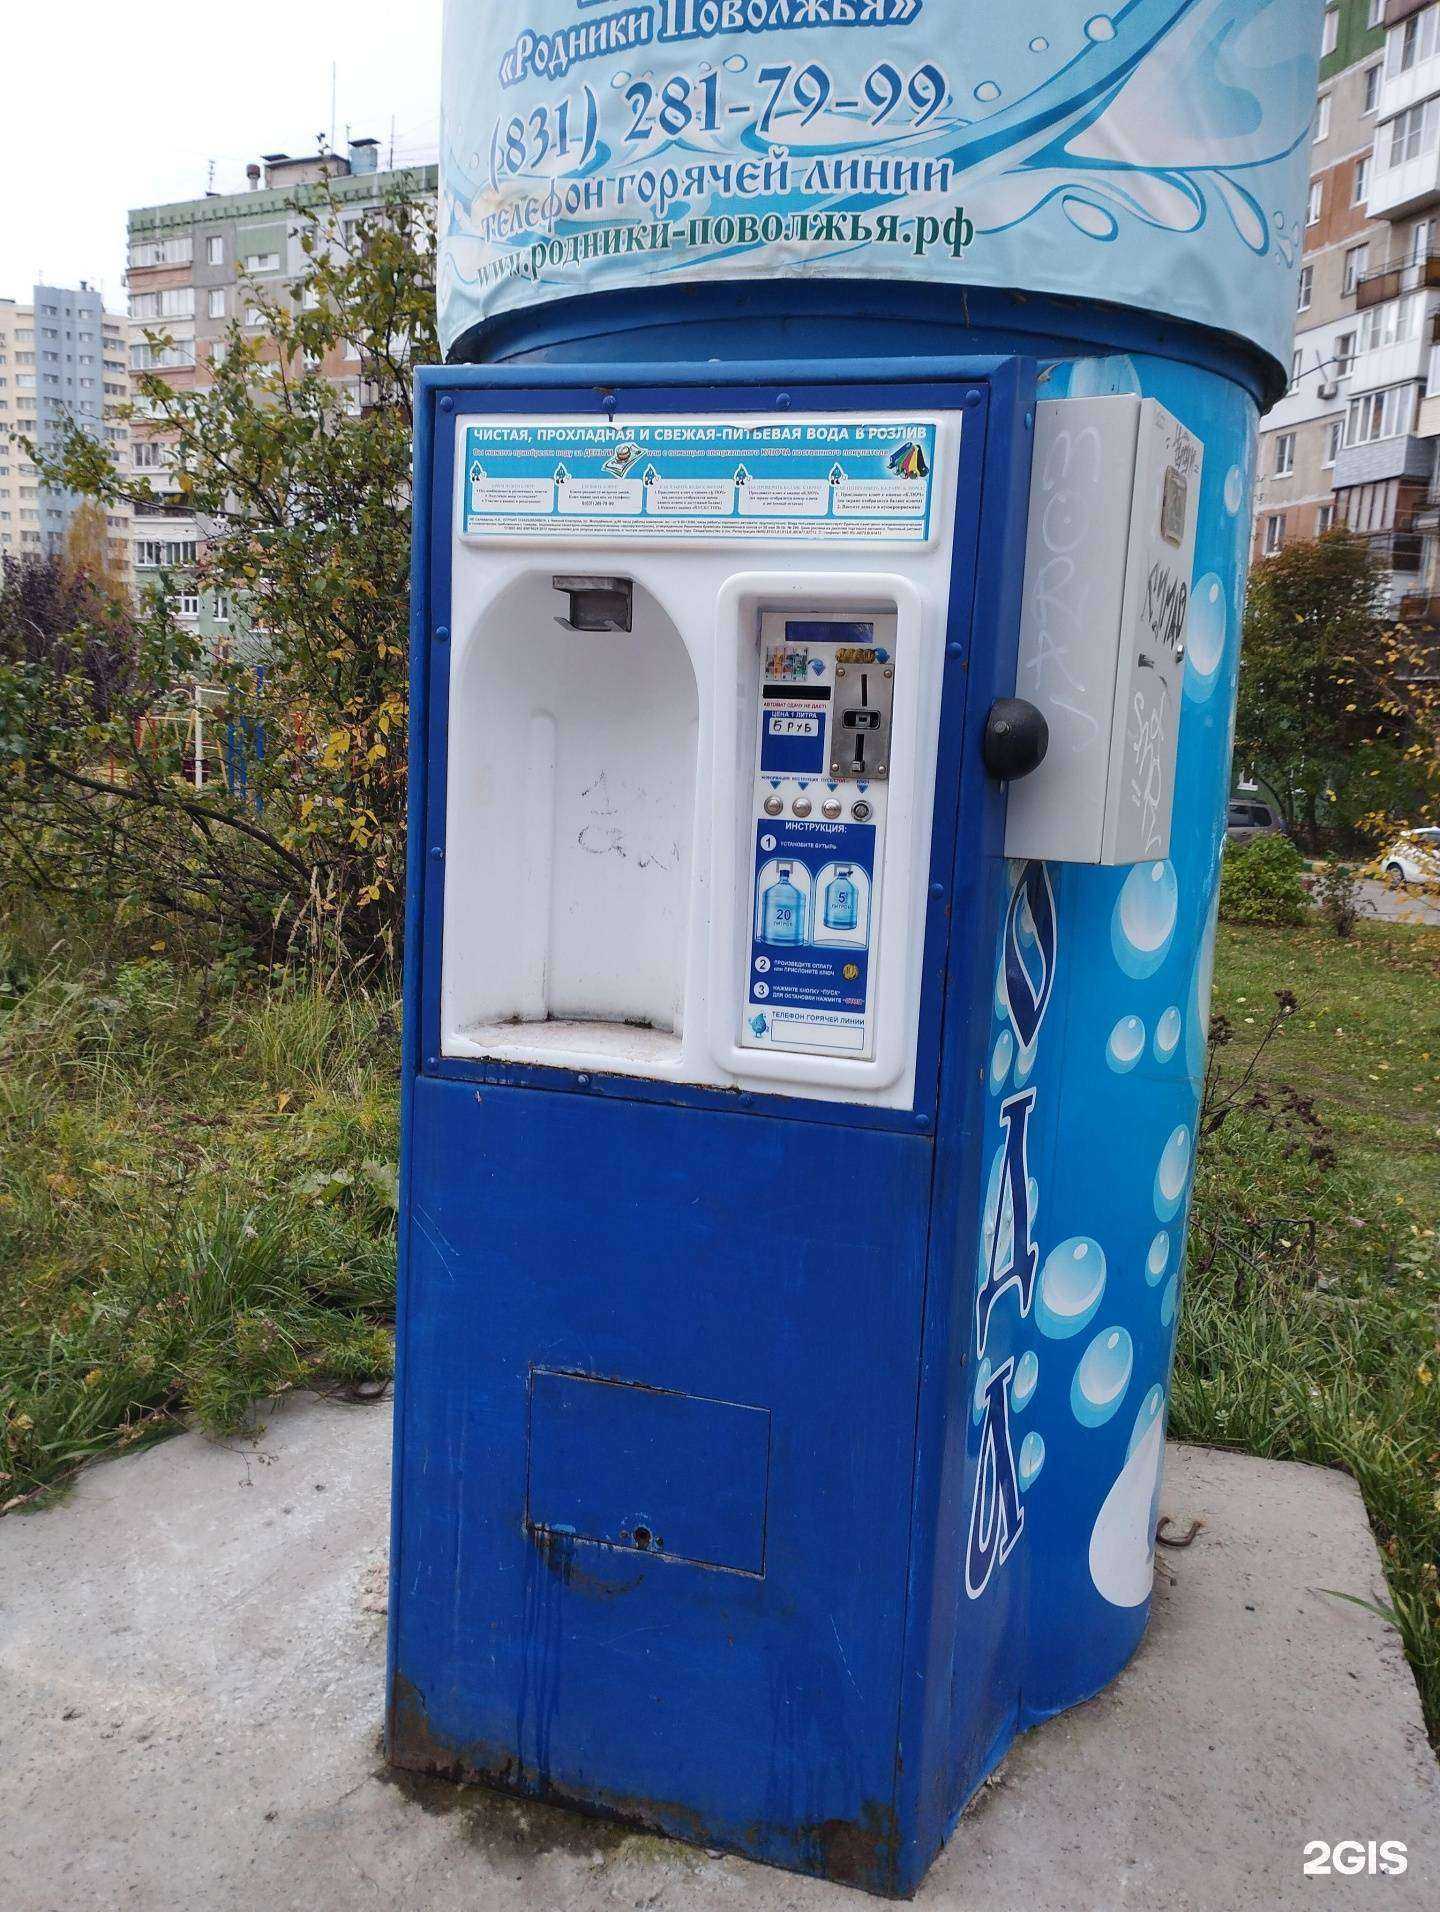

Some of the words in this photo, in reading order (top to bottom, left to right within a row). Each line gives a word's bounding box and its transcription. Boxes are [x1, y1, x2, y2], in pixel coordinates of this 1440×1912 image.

[501, 11, 649, 82] «Родники
[489, 84, 598, 190] (831)
[624, 64, 947, 142] 281-79-99
[804, 158, 954, 195] линии
[476, 207, 976, 285] www.родники-поволжья.рф
[474, 429, 532, 444] ЧИСТАЯ,
[537, 429, 635, 442] ПРОХЛАДНАЯ
[640, 429, 650, 441] И
[806, 428, 849, 443] ВОДА
[855, 427, 865, 440] В
[868, 427, 927, 440] РОЗЛИВ
[787, 722, 812, 733] РУБ
[785, 822, 848, 834] ИНСТРУКЦИЯ:
[765, 837, 771, 847] 1
[838, 891, 847, 903] 5
[776, 909, 791, 920] 20
[760, 959, 767, 969] 2
[758, 985, 765, 995] 3
[772, 1011, 805, 1020] ТЕЛЕФОН
[807, 1015, 839, 1024] ГОРЯЧЕЙ
[840, 1017, 865, 1025] ЛИНИИ
